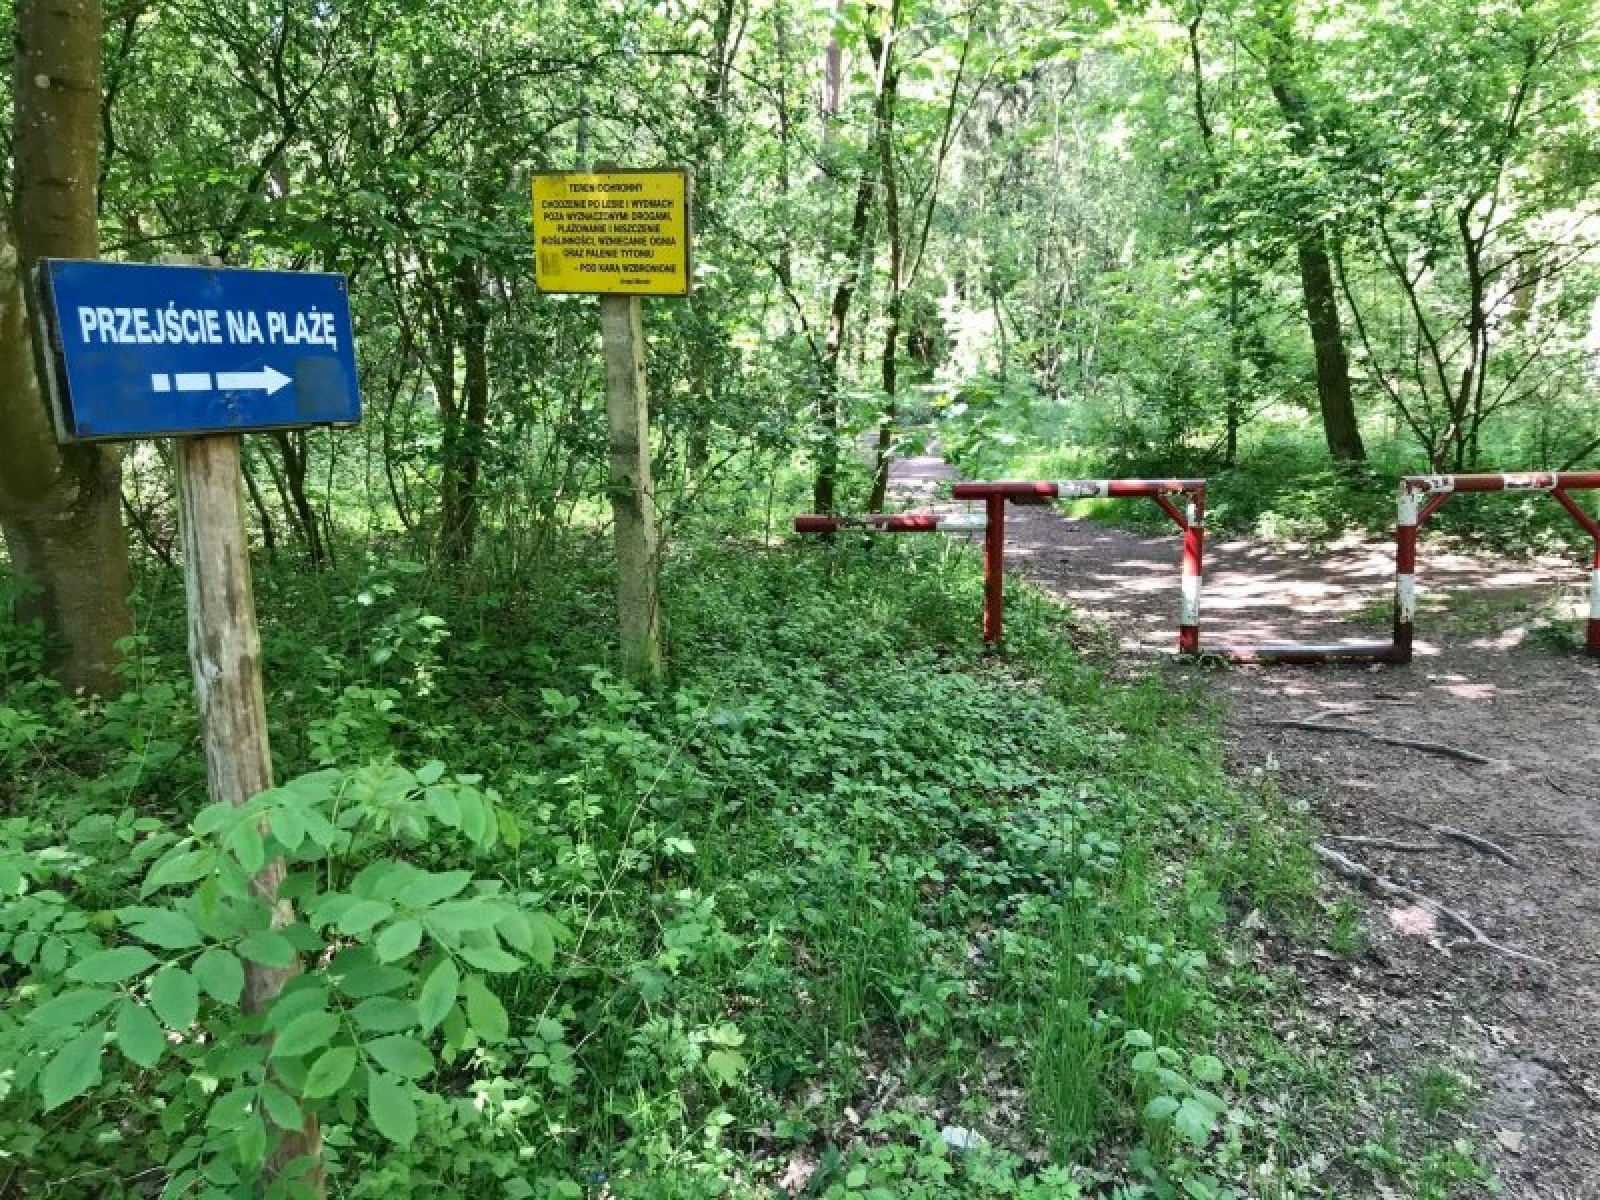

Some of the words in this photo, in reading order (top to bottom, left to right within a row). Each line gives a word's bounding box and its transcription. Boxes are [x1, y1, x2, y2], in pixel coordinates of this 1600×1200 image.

[570, 184, 594, 192] TEREN
[596, 184, 642, 192] OCHRONNY
[542, 200, 586, 208] CHODZENIE
[588, 200, 600, 208] PO
[602, 200, 624, 208] LESIE
[632, 200, 674, 208] WYDMACH
[544, 212, 564, 220] POZA
[566, 212, 628, 220] WYZNACZONYMI
[614, 224, 660, 232] NISZCZENIE
[650, 236, 676, 246] OGNIA
[562, 250, 583, 258] ORAZ
[586, 250, 617, 258] PALENIE
[620, 250, 654, 258] TYTONIU
[580, 264, 596, 272] POD
[622, 264, 676, 273] WZBRONIONE
[78, 300, 222, 344] PRZEJŚCIE
[226, 310, 264, 344] NA
[266, 306, 338, 352] PLAŻĘ
